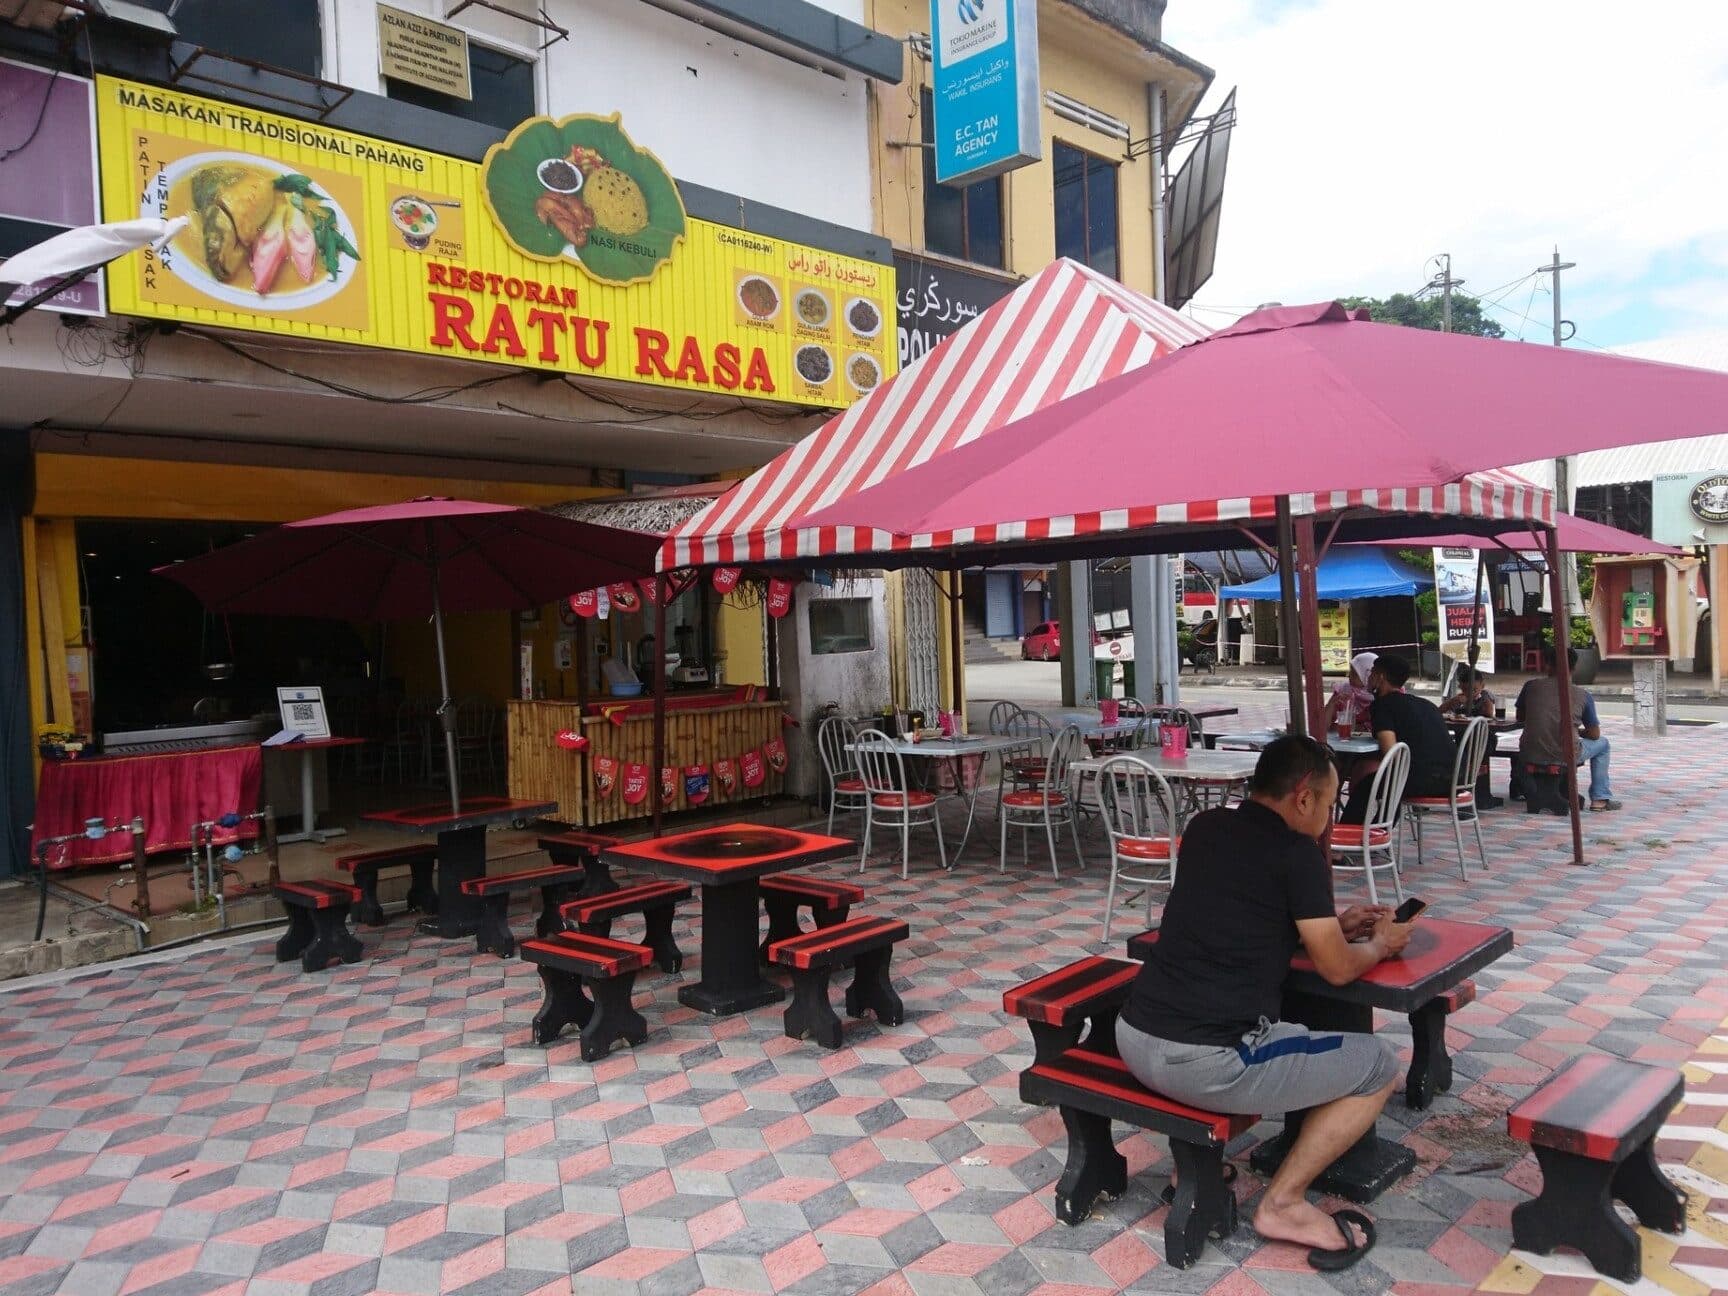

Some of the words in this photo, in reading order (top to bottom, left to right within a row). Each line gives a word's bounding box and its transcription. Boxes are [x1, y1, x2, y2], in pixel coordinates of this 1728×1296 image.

[382, 14, 406, 29] AZLAN
[407, 22, 422, 34] AZIZ
[429, 29, 461, 46] PARTNERS
[970, 20, 997, 37] MARINE
[399, 33, 415, 44] PUBLIC
[416, 40, 447, 54] ACCOUNTANTS
[950, 39, 978, 56] INSURANCE
[425, 73, 456, 88] ACCOUNTANTS
[948, 88, 968, 101] WAKIL
[969, 73, 1002, 93] INSURANS
[119, 88, 221, 126] MASAKAN
[226, 114, 350, 155] TRADISIONAL
[356, 143, 424, 172] PAHANG
[975, 114, 998, 133] TAN
[955, 130, 998, 157] AGENCY
[138, 136, 151, 205] PATIN
[434, 238, 462, 250] PUDING
[439, 247, 458, 257] RAJA
[590, 234, 616, 251] NASI
[618, 242, 657, 259] KEBULI
[427, 262, 577, 309] RESTORAN
[796, 328, 815, 338] DAGING
[813, 325, 829, 333] LEMAK
[428, 292, 610, 368] RATU
[634, 327, 776, 392] RASA
[852, 333, 875, 342] RENDANG
[804, 383, 825, 391] SAMBAL
[1656, 474, 1688, 482] RESTORAN
[577, 596, 593, 605] JOY
[1449, 628, 1486, 638] RUMH
[564, 732, 584, 742] JOY
[627, 783, 641, 792] JOY
